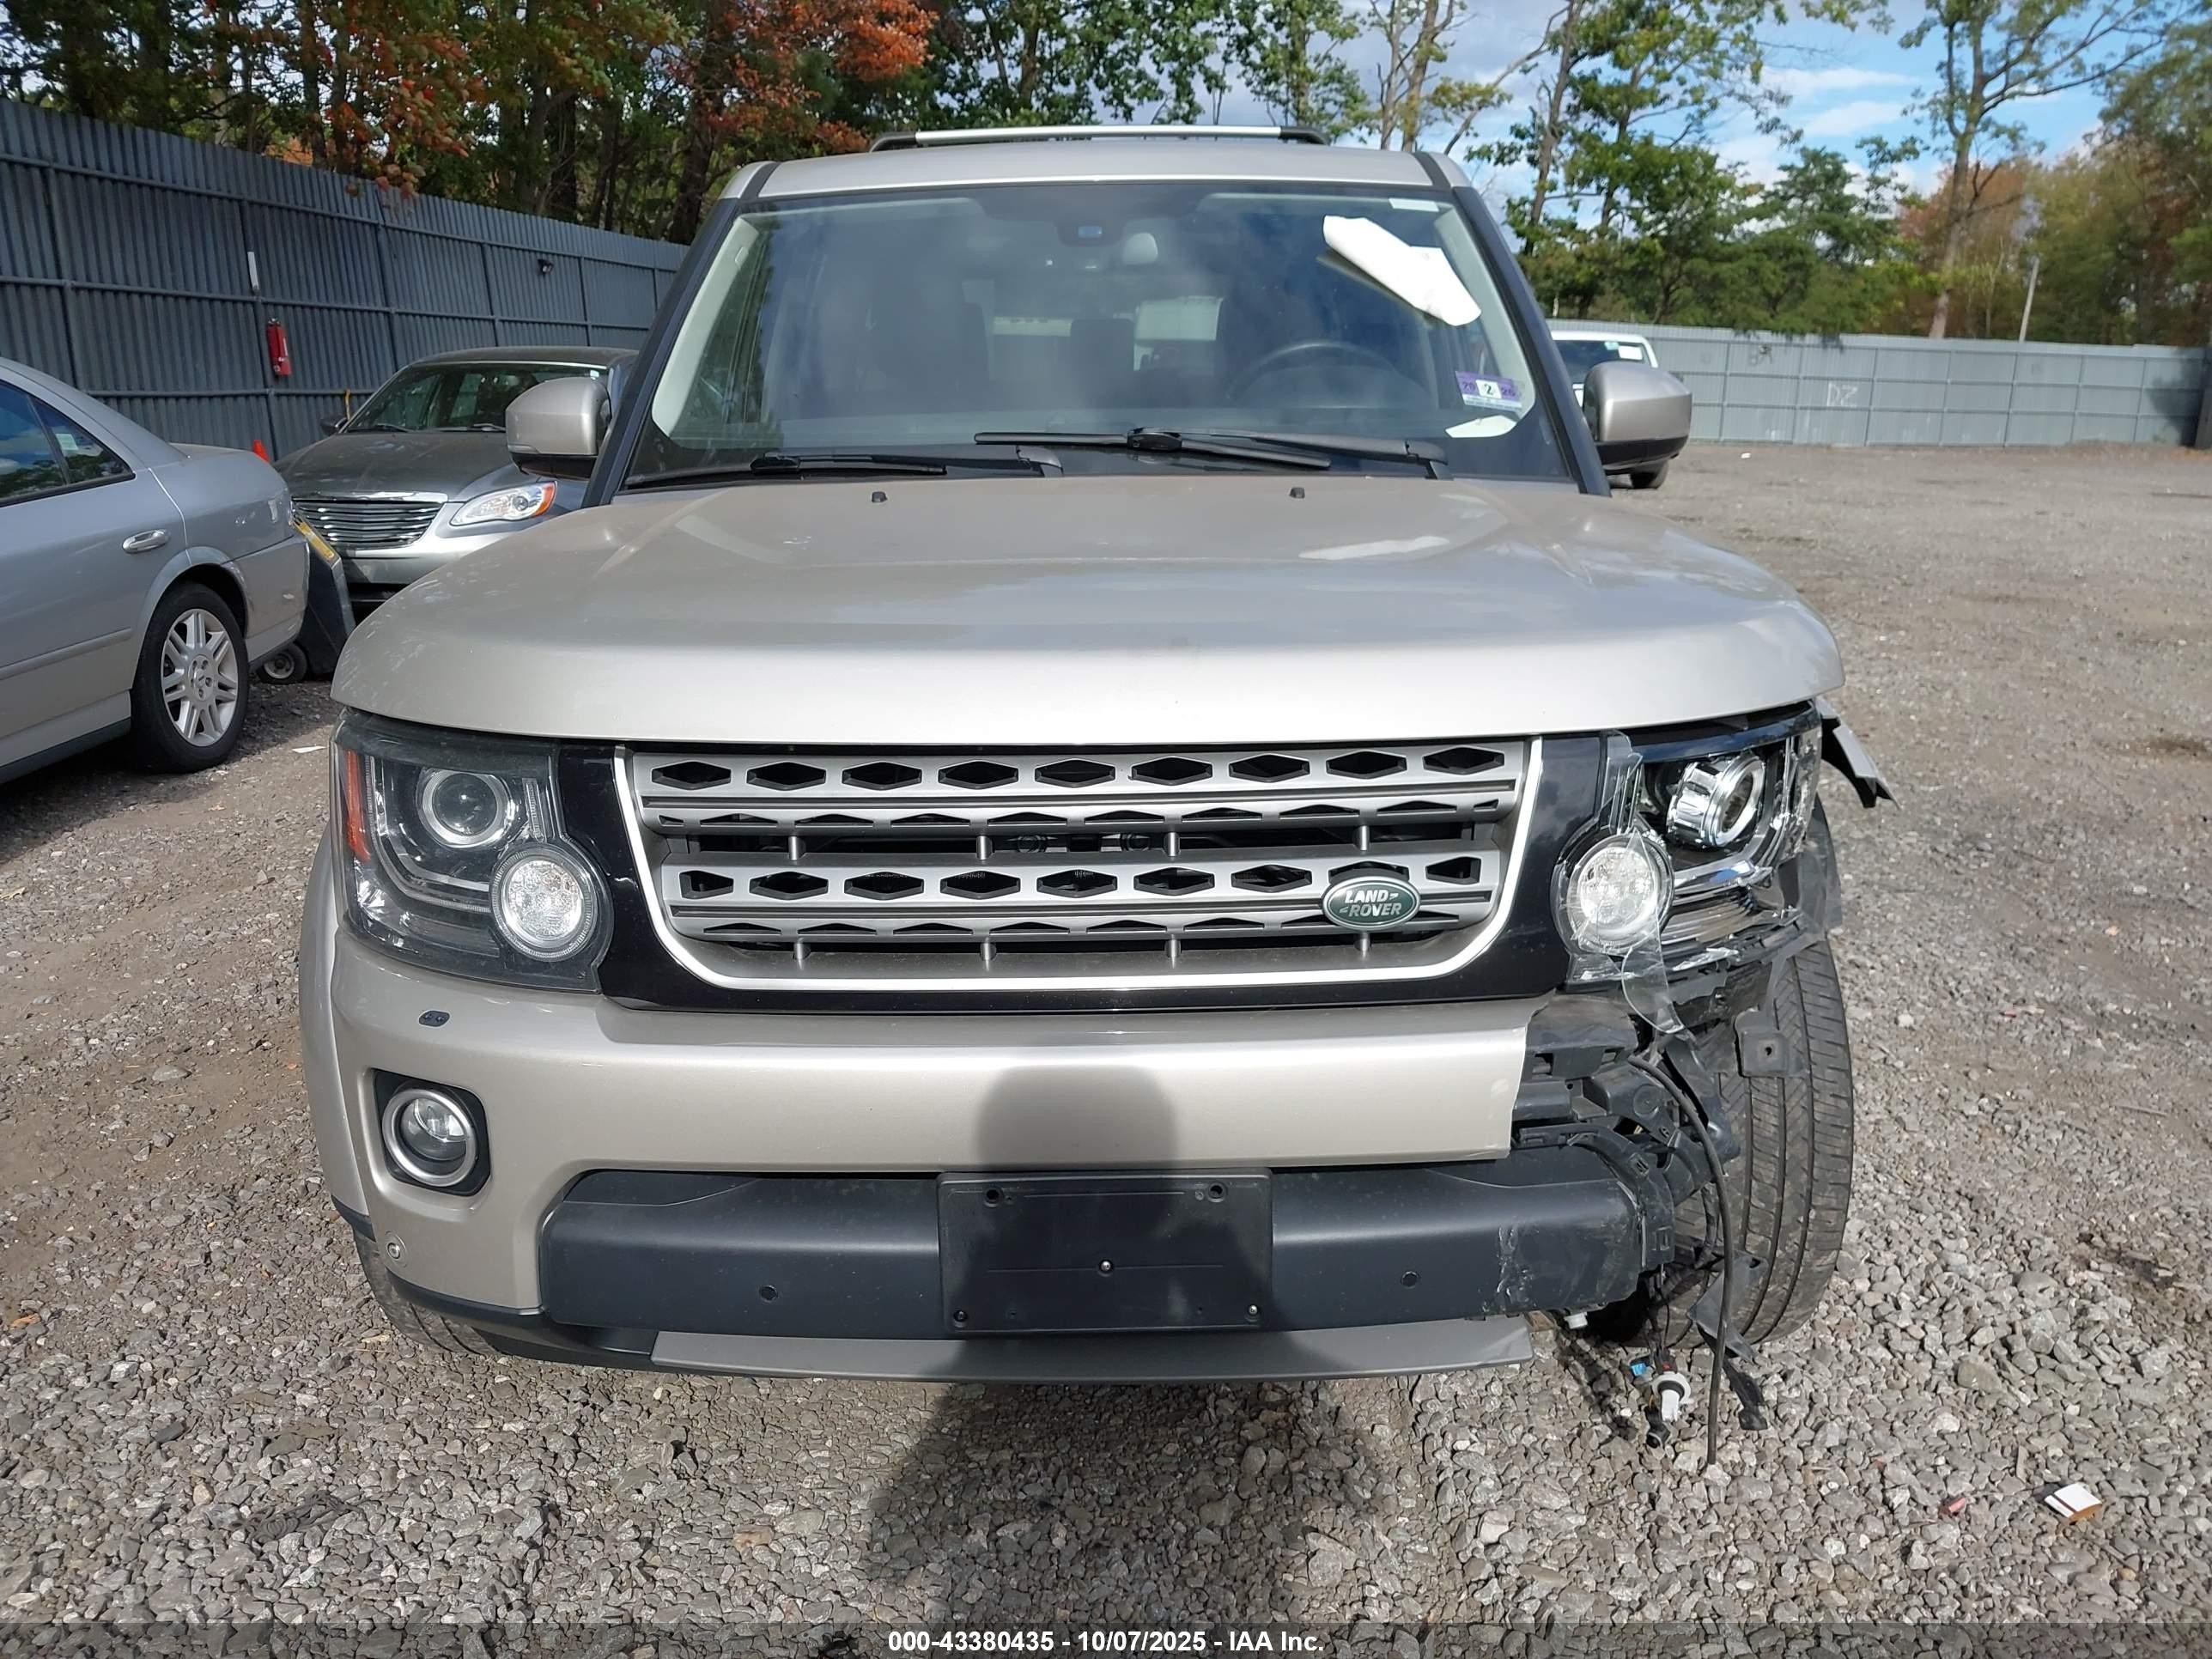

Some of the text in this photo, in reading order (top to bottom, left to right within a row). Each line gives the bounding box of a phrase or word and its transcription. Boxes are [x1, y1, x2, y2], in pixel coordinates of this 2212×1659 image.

[1483, 382, 1494, 396] 2
[1344, 890, 1389, 904] LAND
[1348, 902, 1402, 917] ROVER
